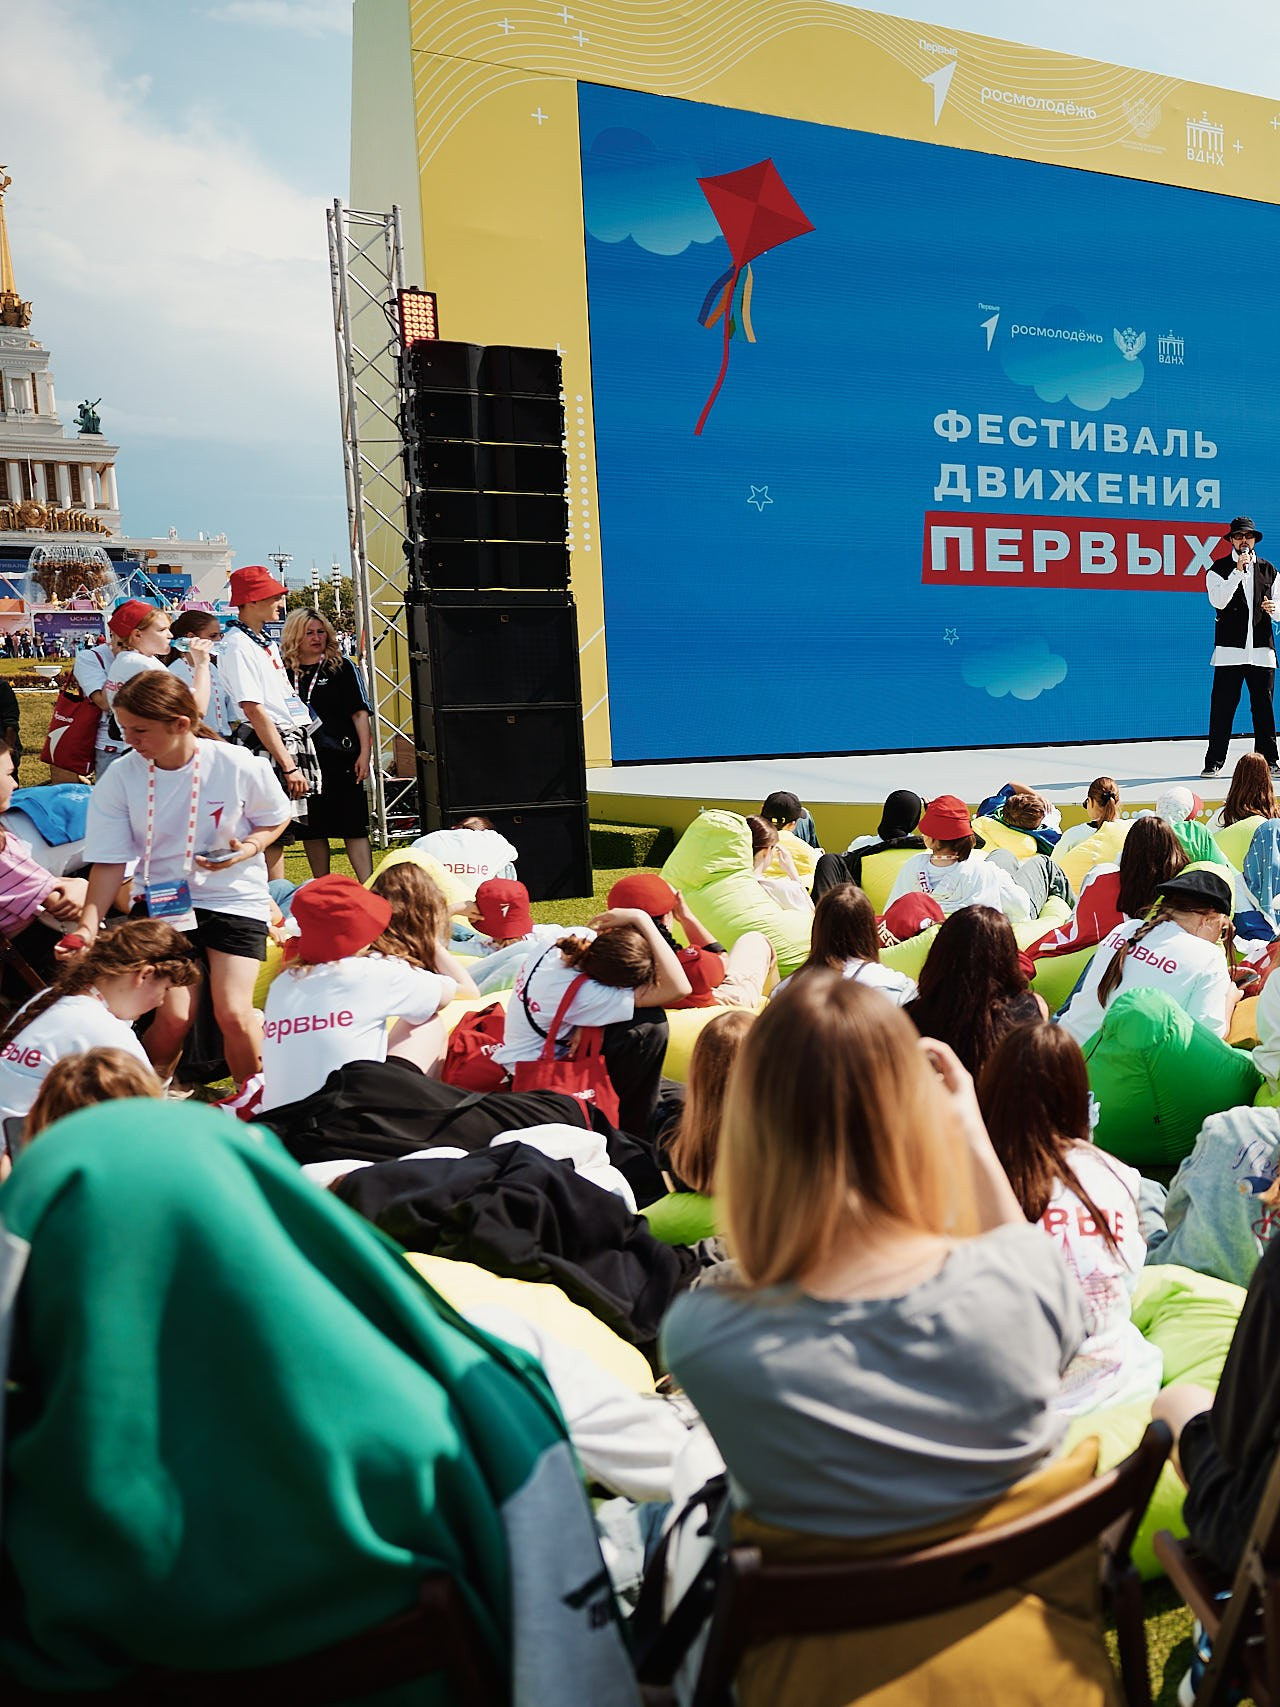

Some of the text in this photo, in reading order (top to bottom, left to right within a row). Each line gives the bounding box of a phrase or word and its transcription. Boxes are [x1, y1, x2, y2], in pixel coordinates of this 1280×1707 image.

[918, 39, 959, 57] Первые
[980, 87, 1097, 120] росмолодёжь
[1186, 148, 1224, 166] ВДНХ
[1011, 323, 1104, 344] росмолодёжь
[1158, 354, 1185, 366] ВДНХ
[933, 409, 1218, 459] ФЕСТИВАЛЬ
[933, 463, 1221, 509] ДВИЖЕНИЯ
[930, 526, 1222, 576] ПЕРВЫХ
[262, 1010, 354, 1044] ервые
